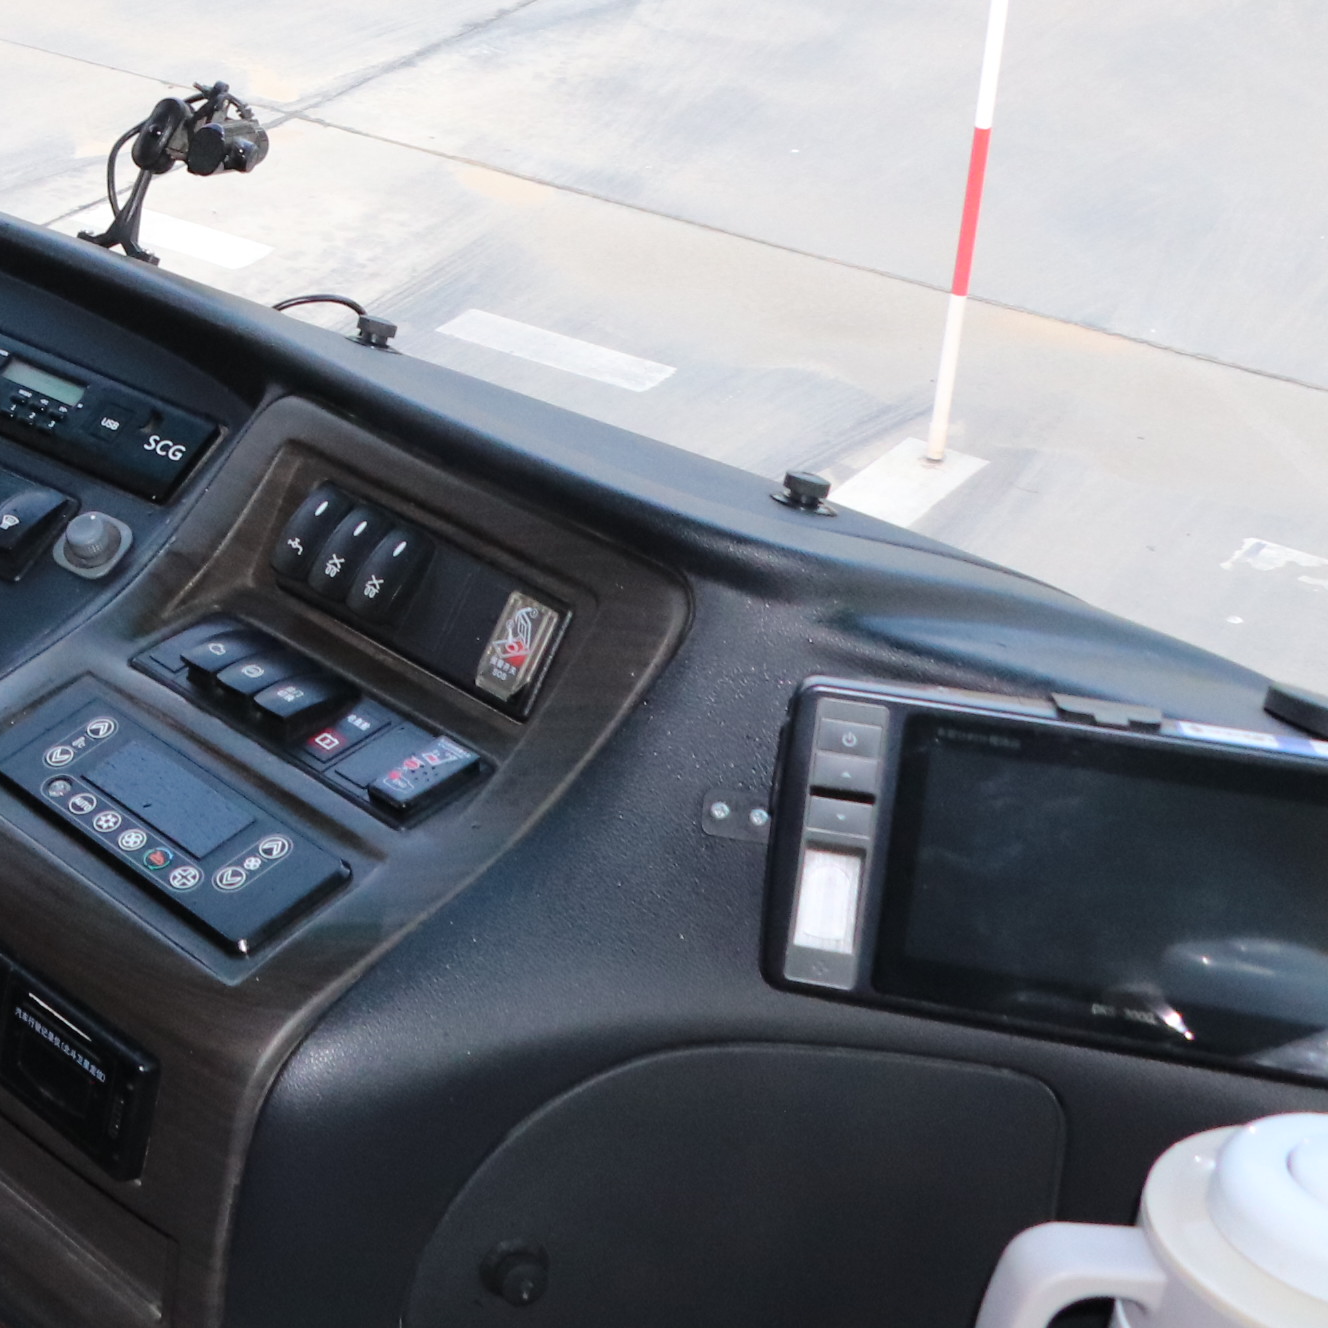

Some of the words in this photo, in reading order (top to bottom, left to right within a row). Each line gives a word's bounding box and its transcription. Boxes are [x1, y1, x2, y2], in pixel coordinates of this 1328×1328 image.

[101, 417, 120, 431] USB
[144, 435, 187, 461] SCG
[492, 668, 507, 681] SOS
[73, 797, 92, 812] AUTO
